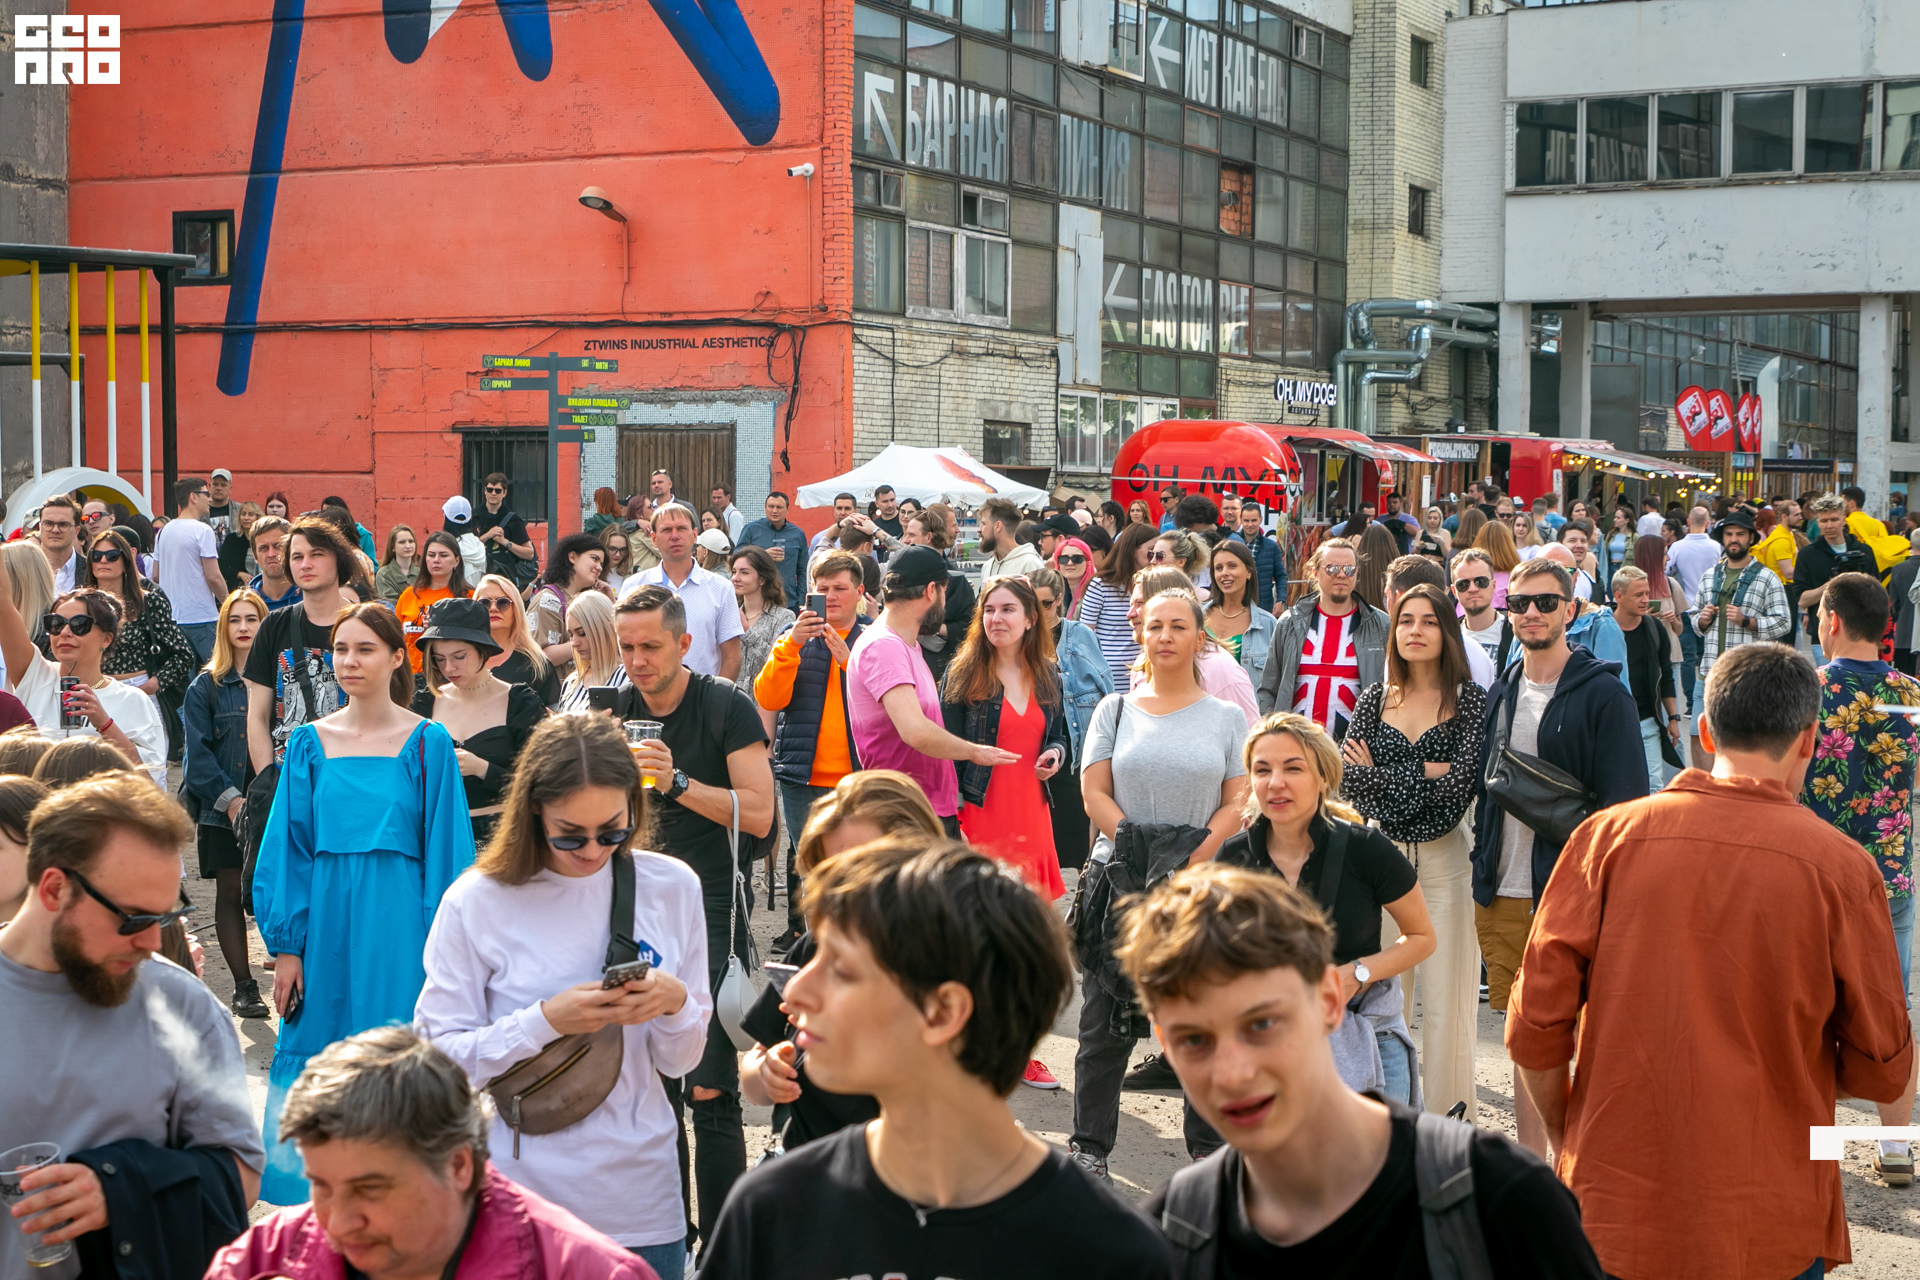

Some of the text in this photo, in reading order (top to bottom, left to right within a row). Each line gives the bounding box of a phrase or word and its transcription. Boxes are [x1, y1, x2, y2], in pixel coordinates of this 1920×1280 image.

[906, 71, 1130, 211] БАРНАЯ ЛИНИЯ
[584, 335, 775, 351] ZTWINS INDUSTRIAL AESTHETICS
[494, 357, 531, 367] БАРНАЯ ЛИНИЯ
[491, 379, 512, 389] ПРИЧАЛ
[1295, 380, 1314, 402] MY
[1313, 382, 1337, 406] DOG!
[567, 397, 619, 408] ВХОДНАЯ ПЛОЩАДЬ
[572, 415, 589, 424] ТУАЛЕТ
[1199, 466, 1269, 495] MY
